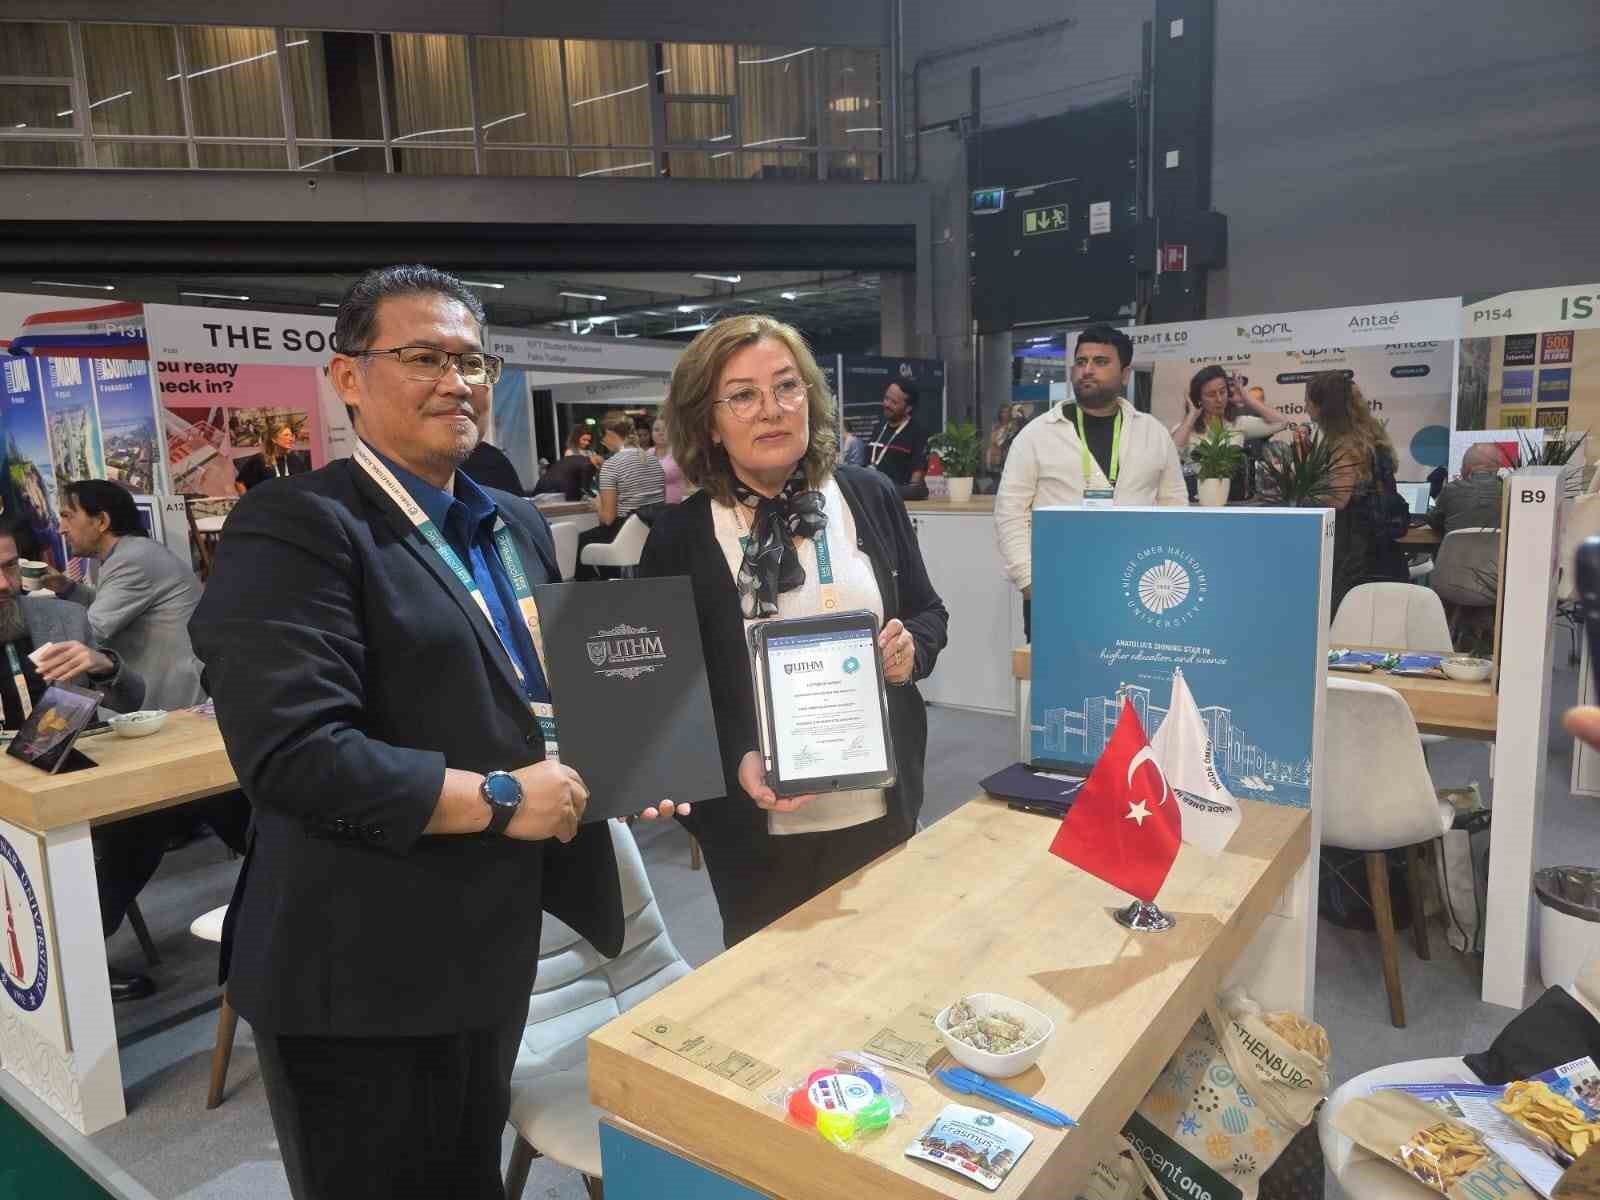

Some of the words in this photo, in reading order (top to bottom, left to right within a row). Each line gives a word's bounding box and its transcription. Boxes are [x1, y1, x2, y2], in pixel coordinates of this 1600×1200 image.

[1473, 308, 1512, 322] P154
[1561, 294, 1600, 320] IS
[1349, 310, 1399, 328] Antaé
[203, 324, 272, 350] THE
[1174, 330, 1188, 342] CO
[1252, 322, 1293, 337] april
[184, 361, 238, 378] ready
[205, 379, 234, 393] in?
[1521, 490, 1546, 503] B9
[166, 502, 185, 512] A12
[607, 637, 665, 656] UTHM
[942, 1123, 995, 1148] Erasmus
[1127, 1131, 1184, 1183] ascent
